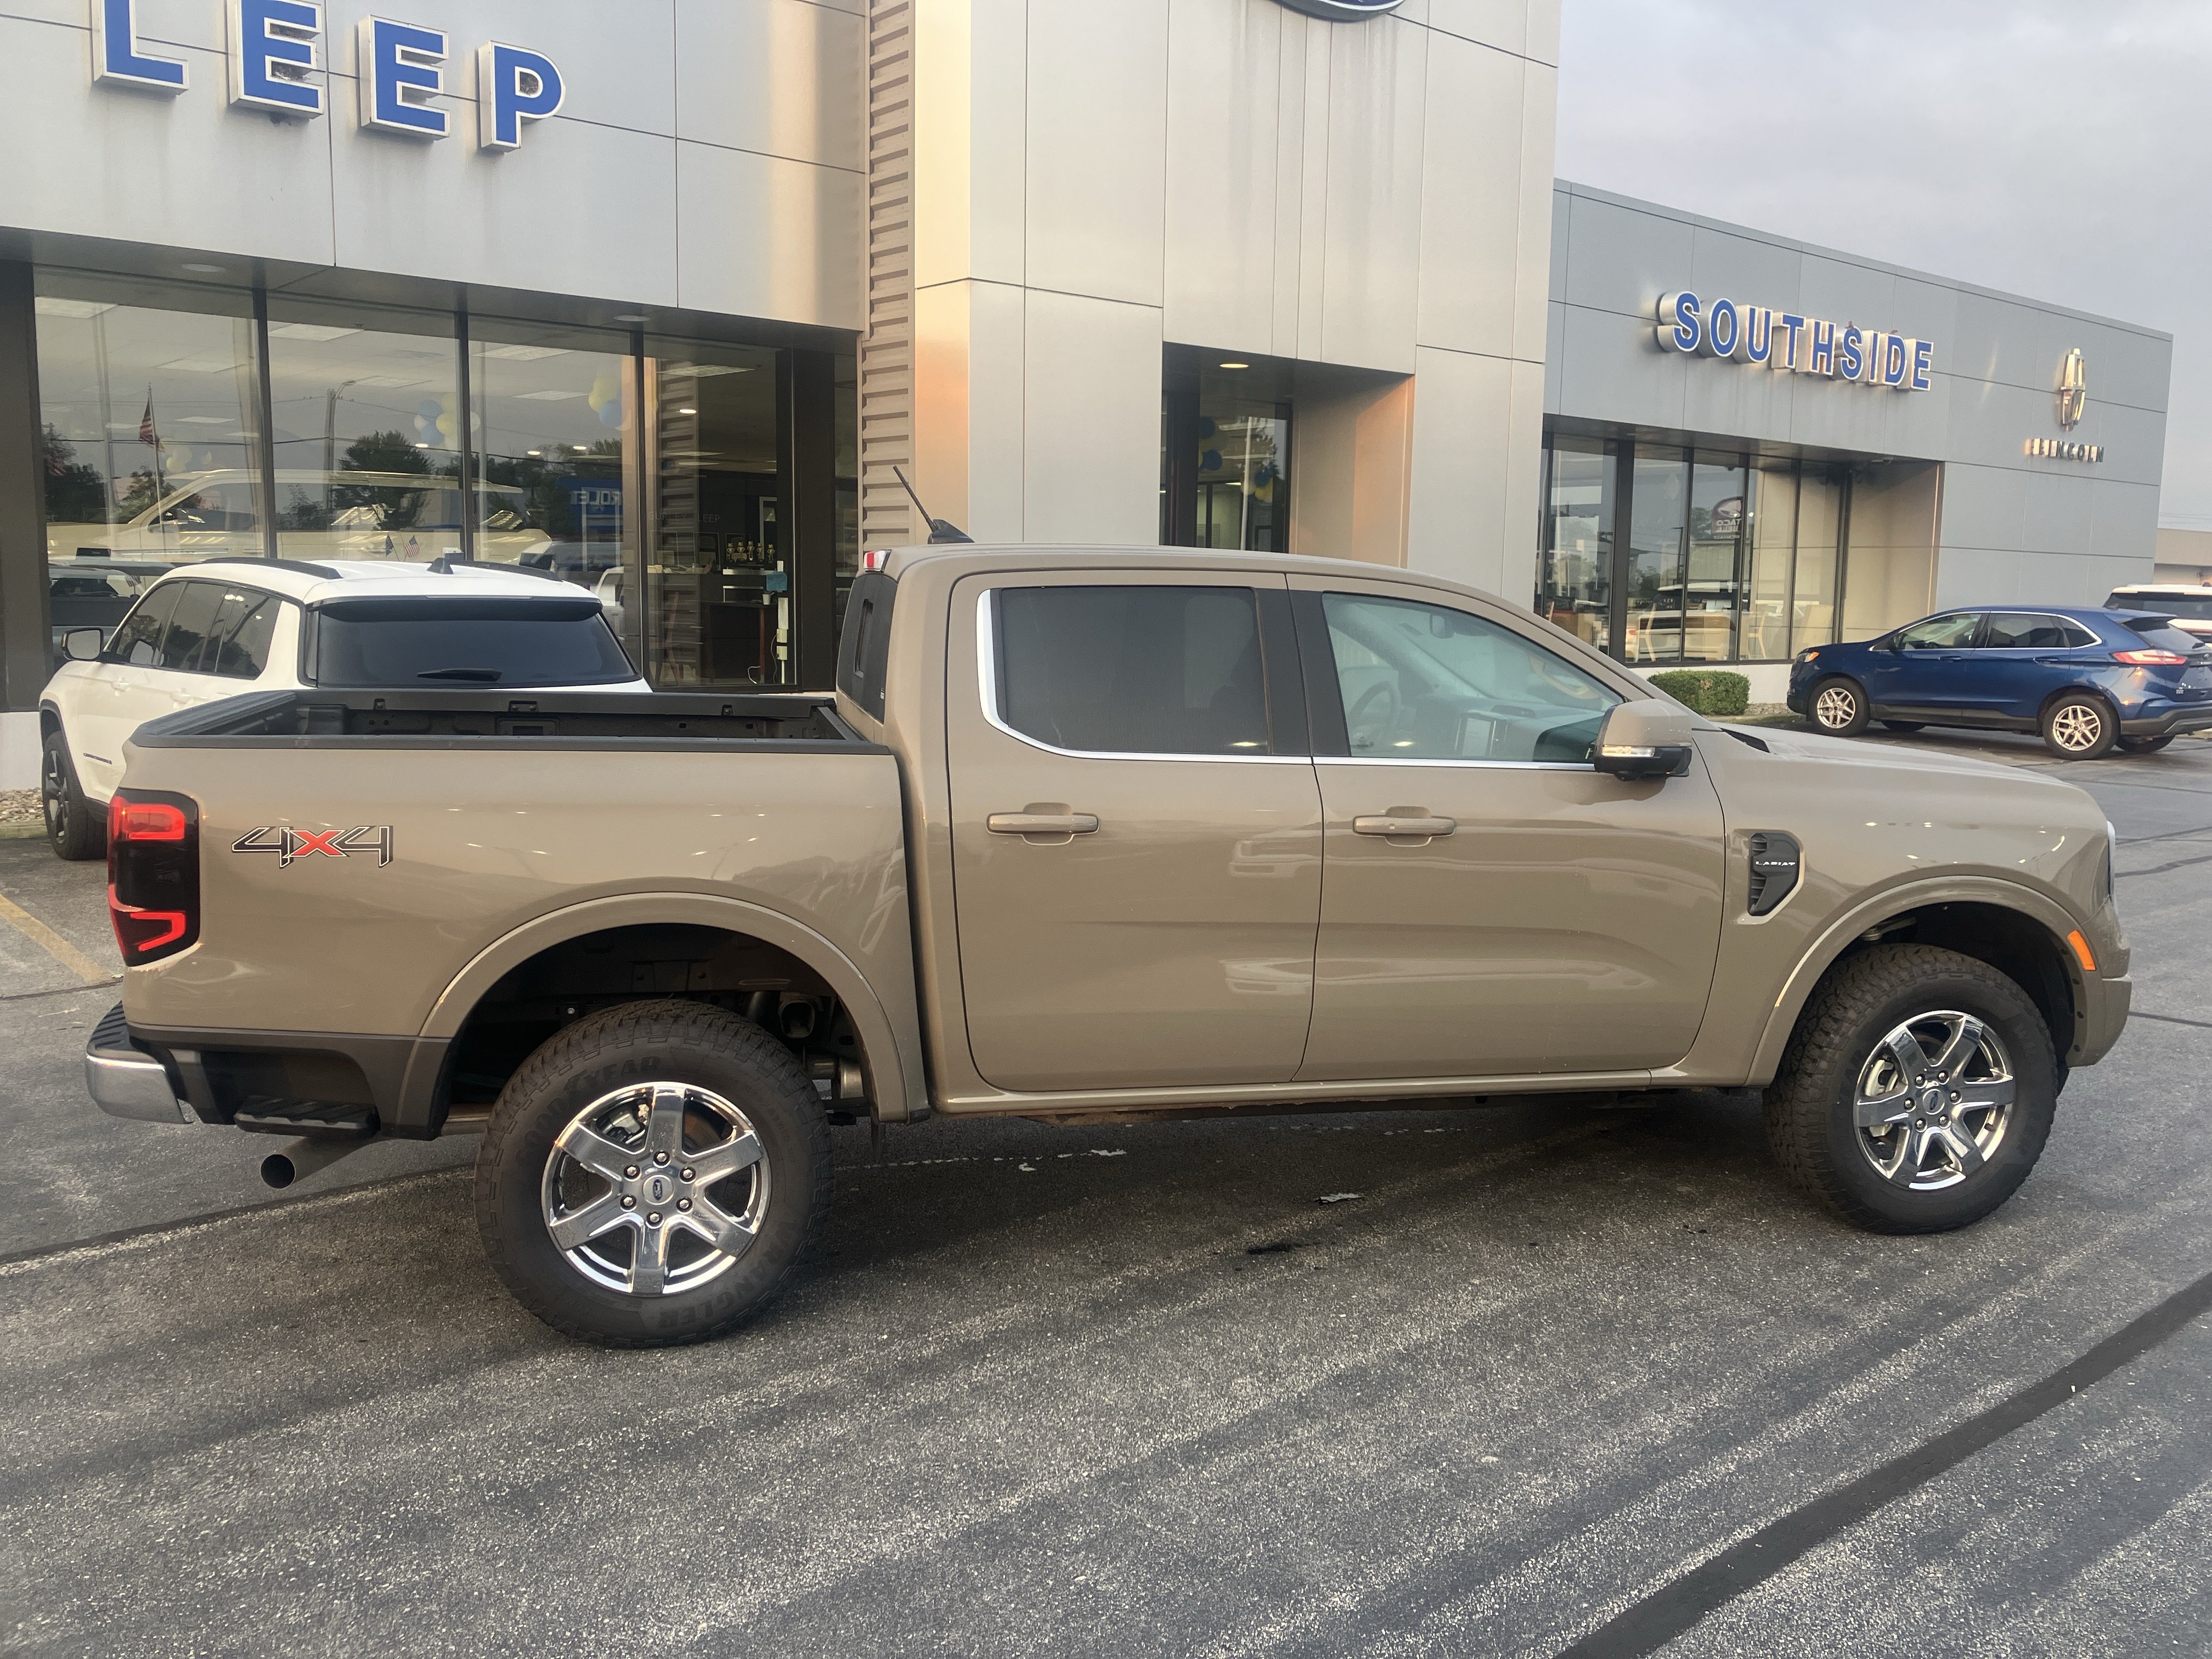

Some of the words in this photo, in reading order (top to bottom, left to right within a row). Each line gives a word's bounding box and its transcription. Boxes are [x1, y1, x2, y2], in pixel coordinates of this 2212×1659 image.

[94, 0, 566, 153] LEEP
[1658, 291, 1934, 392] SOUTHSIDE
[697, 514, 720, 523] LEEP
